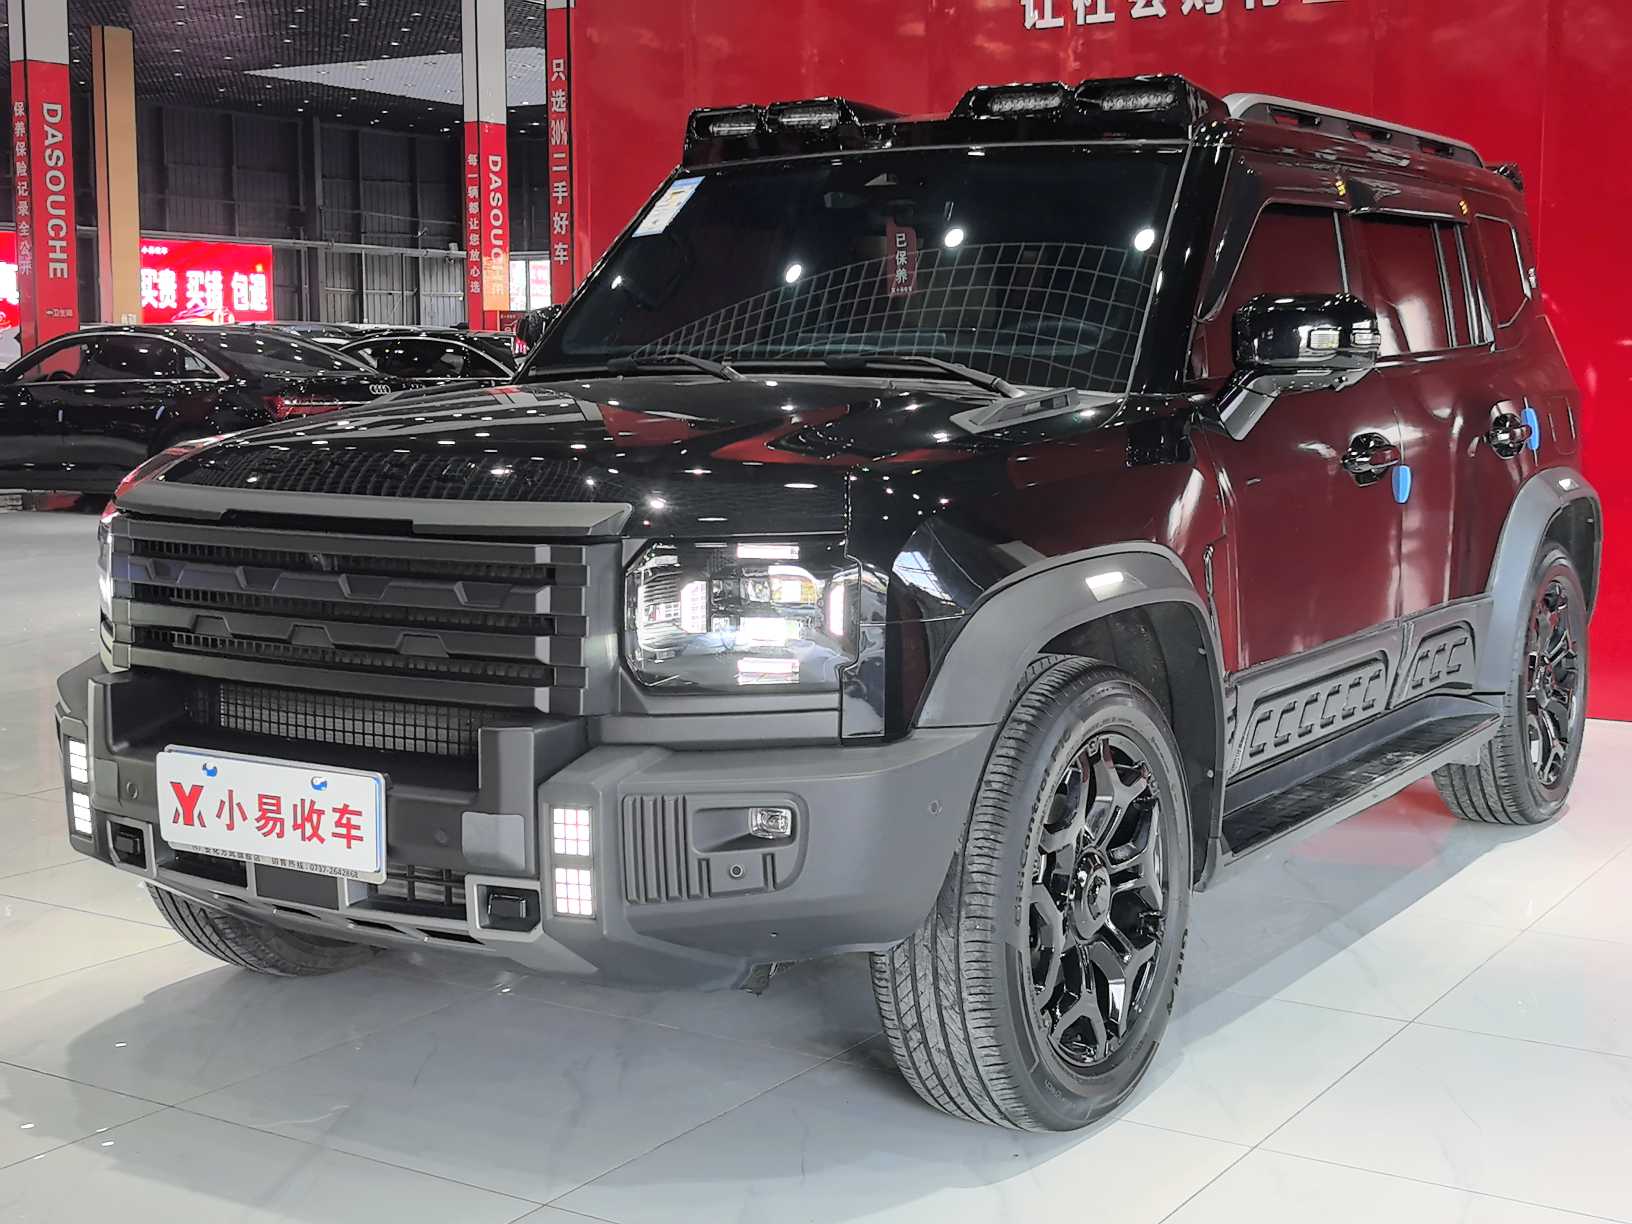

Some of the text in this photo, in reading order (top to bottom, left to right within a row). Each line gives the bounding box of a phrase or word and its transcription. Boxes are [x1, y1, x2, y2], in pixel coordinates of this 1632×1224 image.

[13, 101, 33, 277] 保养保险记录全公开
[43, 102, 69, 279] DASOUCHE
[895, 233, 908, 284] 已保养
[215, 789, 365, 850] 小易收车
